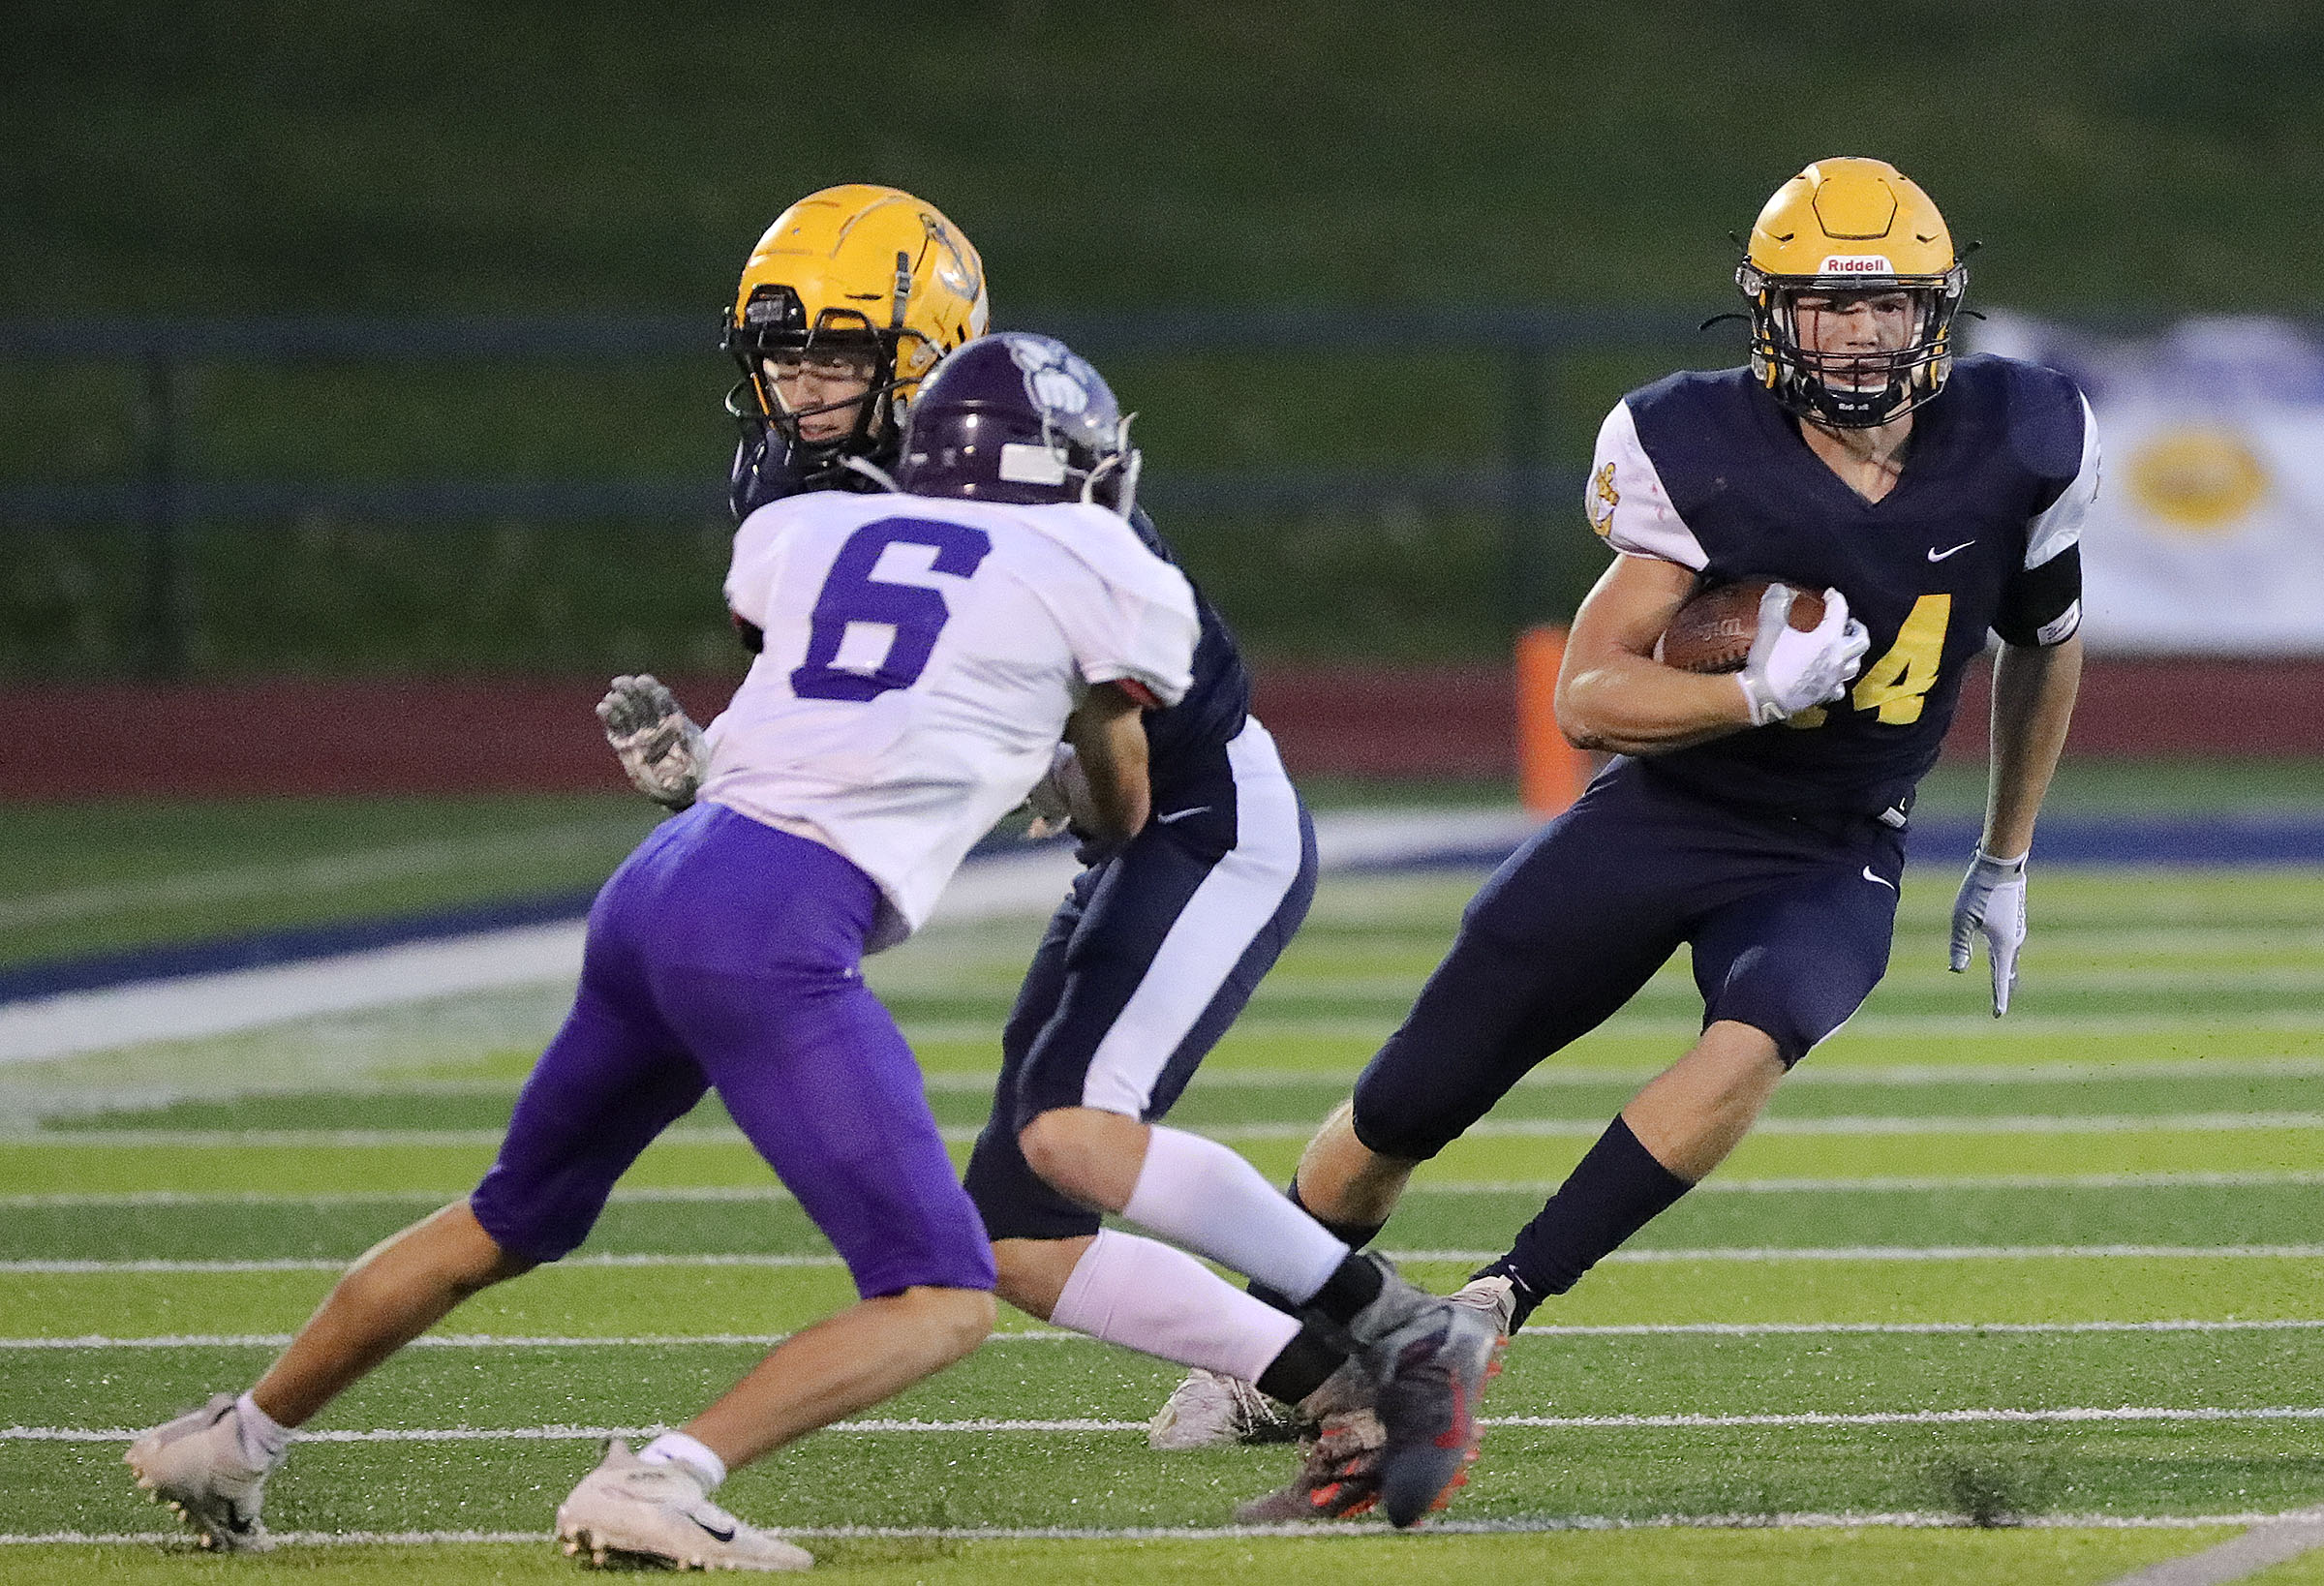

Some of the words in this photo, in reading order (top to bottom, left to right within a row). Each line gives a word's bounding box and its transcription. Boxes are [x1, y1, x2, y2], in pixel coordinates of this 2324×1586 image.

[1828, 259, 1883, 271] Riddell
[789, 517, 994, 703] 6
[1782, 594, 1951, 729] 4
